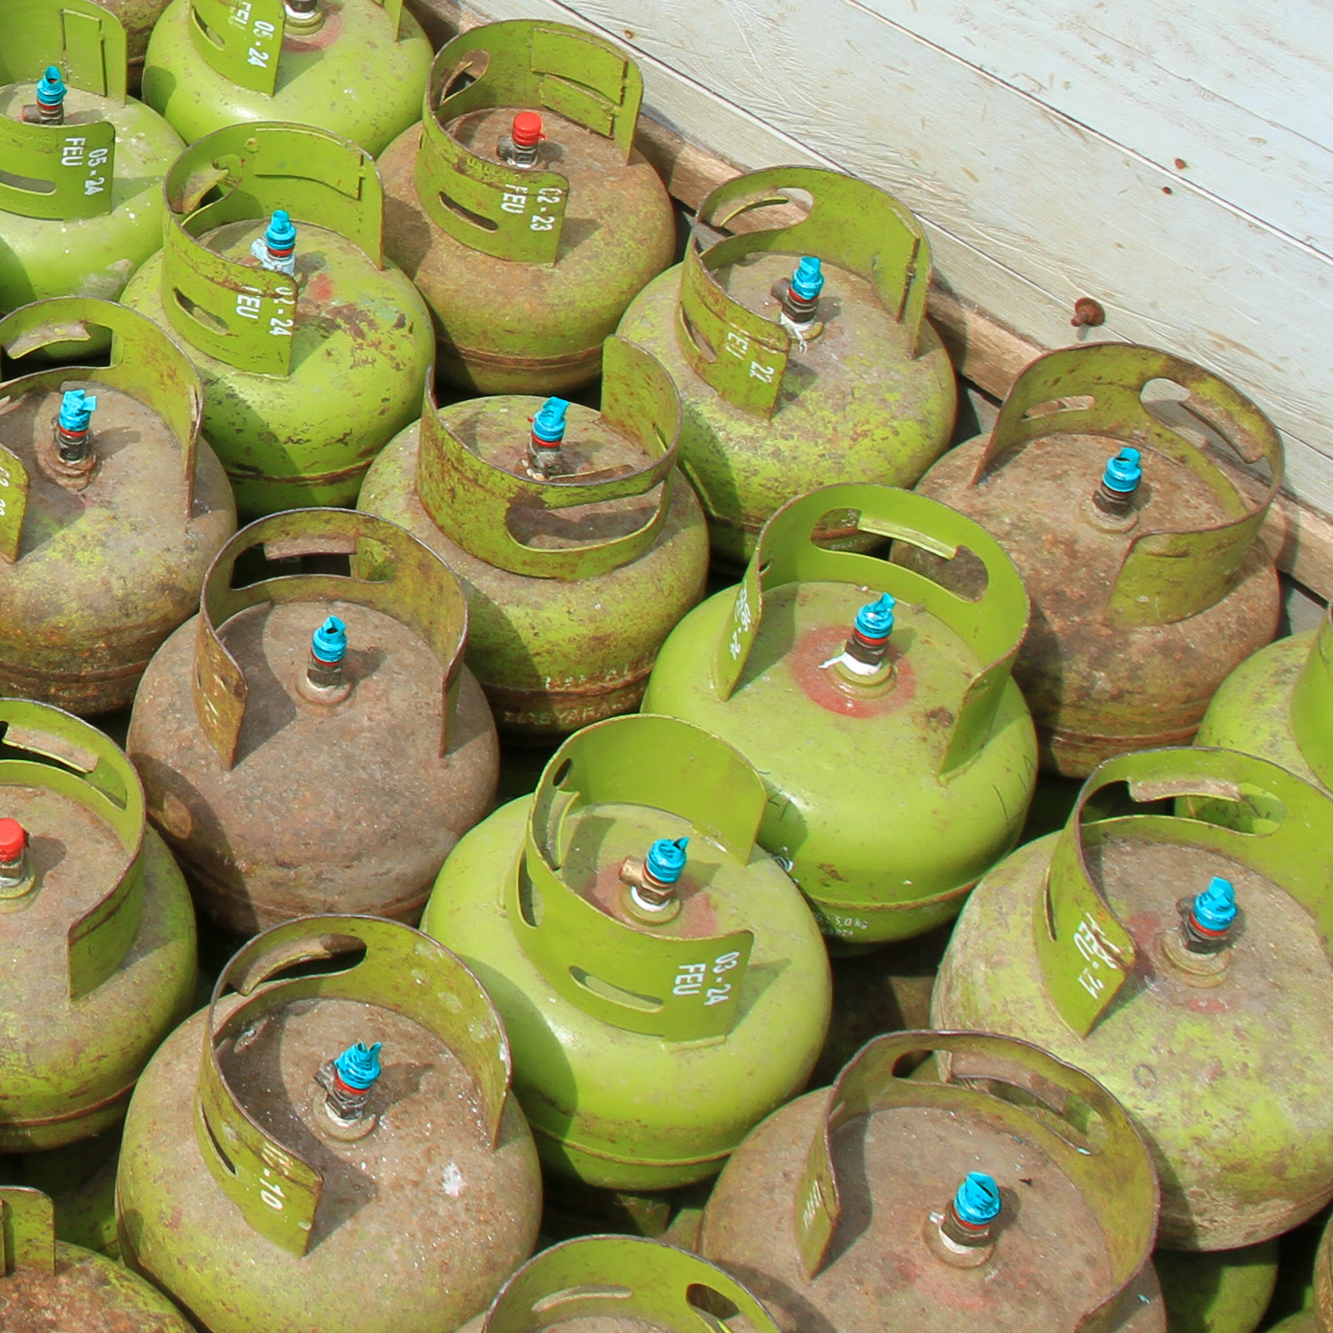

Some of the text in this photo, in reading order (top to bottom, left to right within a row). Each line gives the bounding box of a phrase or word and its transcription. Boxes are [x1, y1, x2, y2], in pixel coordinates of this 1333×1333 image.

[247, 19, 276, 69] 05-24
[61, 137, 87, 167] FEU
[84, 147, 109, 196] 05-24
[500, 183, 529, 214] FEU
[673, 962, 707, 996] FEU
[703, 951, 740, 1006] 03-24
